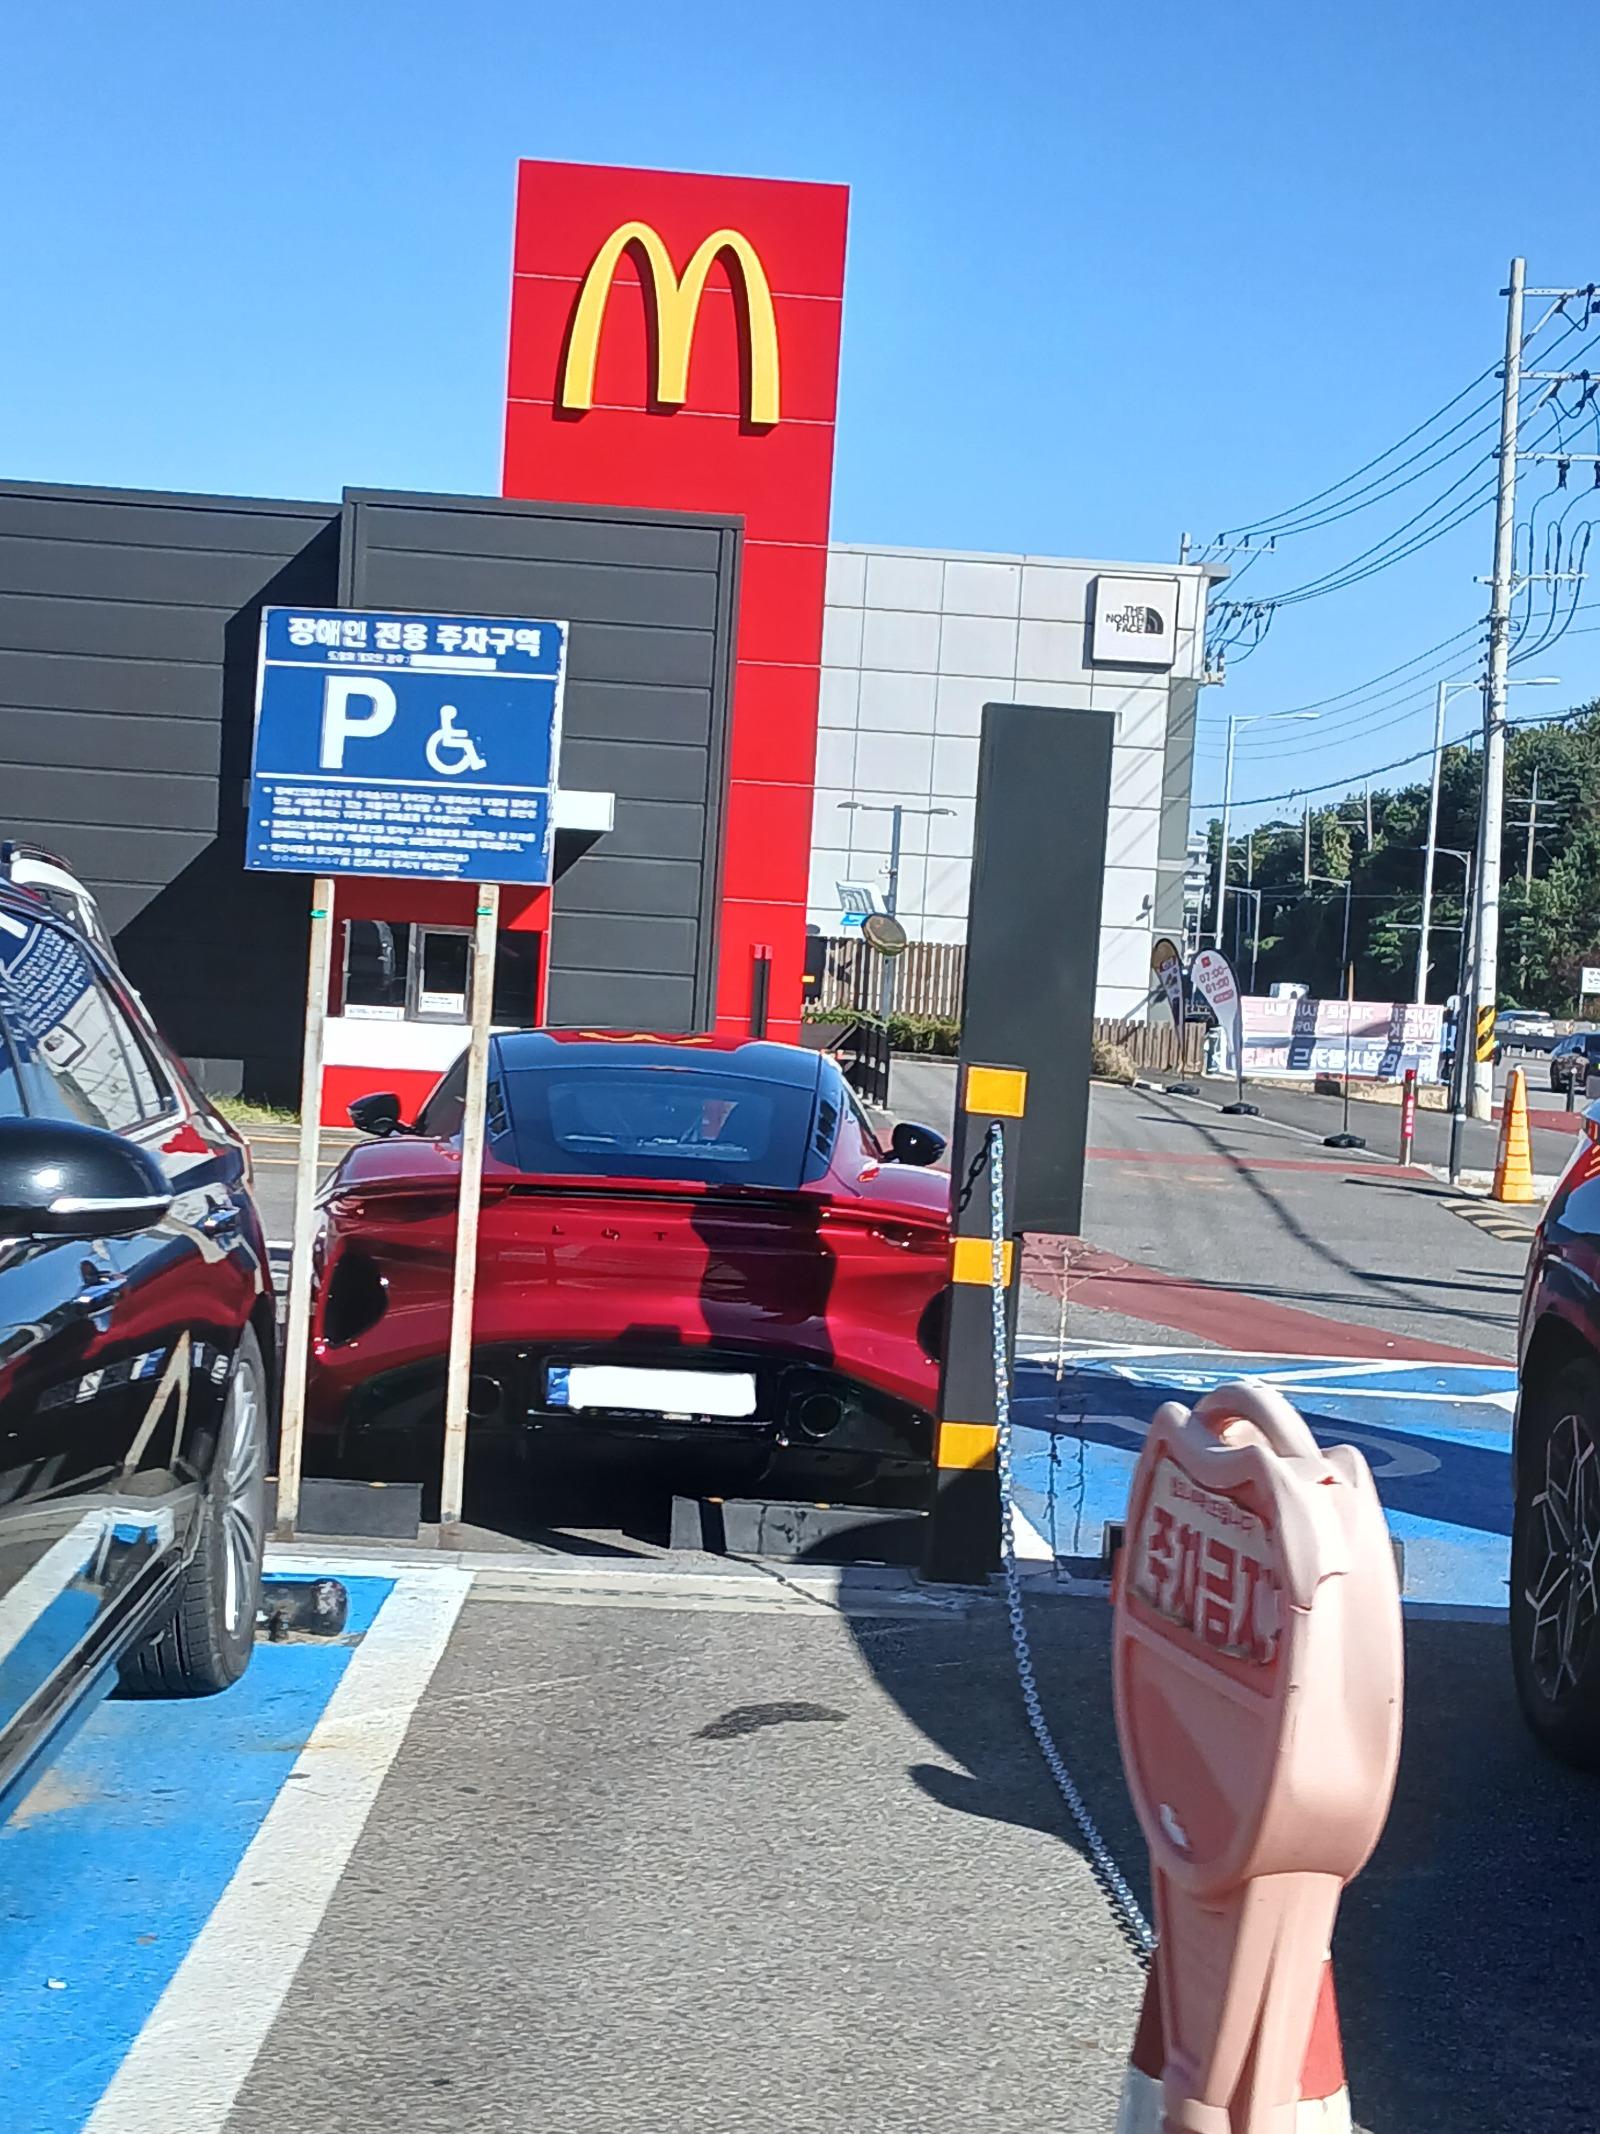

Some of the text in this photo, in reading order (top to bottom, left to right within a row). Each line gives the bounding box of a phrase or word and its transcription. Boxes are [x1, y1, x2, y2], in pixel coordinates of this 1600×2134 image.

[1124, 605, 1145, 616] THE
[1105, 613, 1145, 624] NORTH
[1115, 623, 1143, 634] FACE
[288, 617, 368, 648] 장애인
[374, 620, 428, 651] 전용
[436, 624, 542, 658] 주차구역
[319, 675, 397, 769] P
